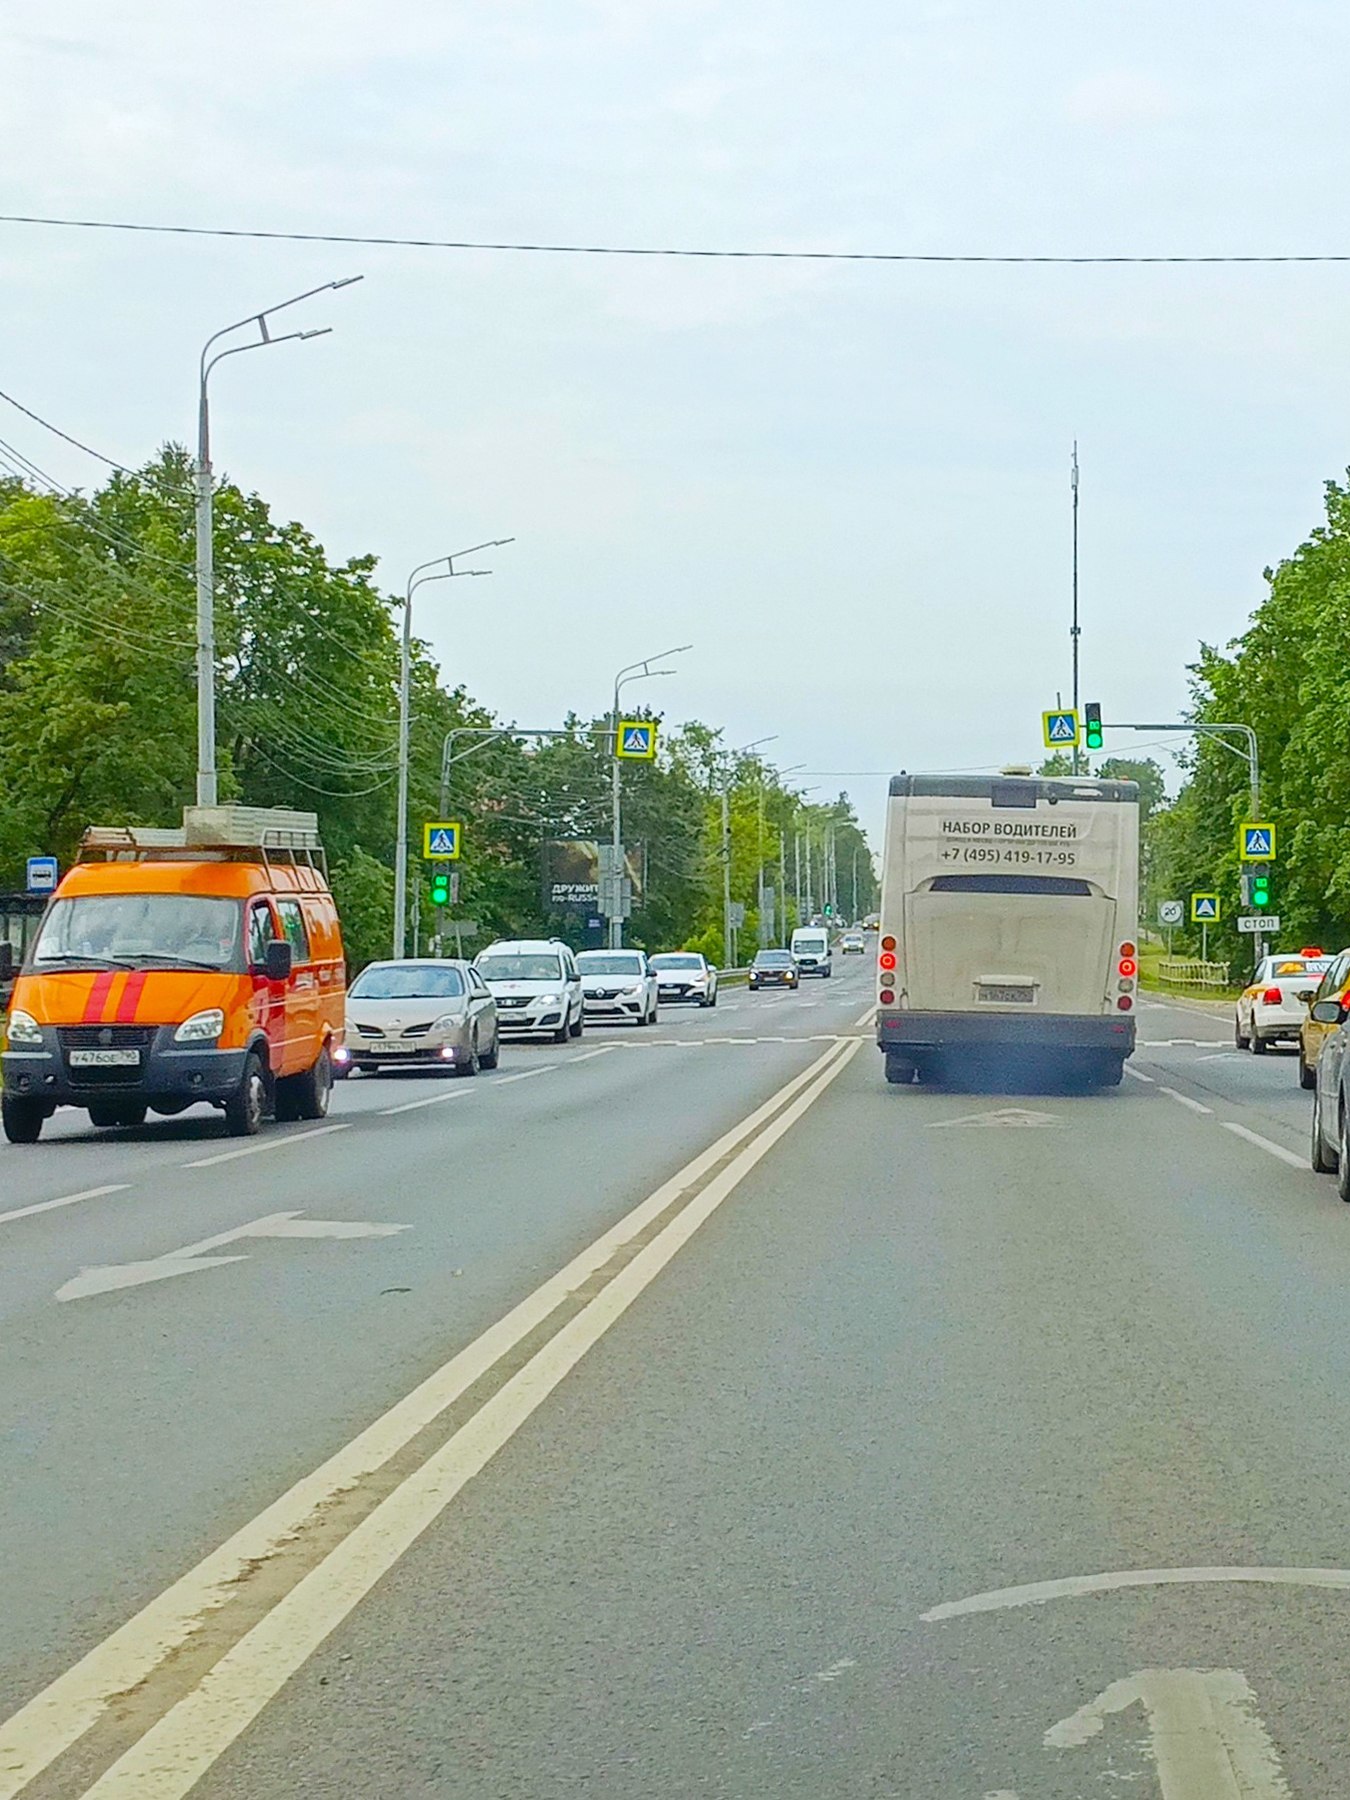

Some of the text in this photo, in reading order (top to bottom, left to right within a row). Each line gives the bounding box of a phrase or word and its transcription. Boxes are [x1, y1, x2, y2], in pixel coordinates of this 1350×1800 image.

[942, 821, 1077, 838] НАБОР ВОДИТЕЛЕЙ
[941, 847, 1076, 865] +7 (495) 419-17-95
[551, 884, 599, 894] ДРУЖИТ
[1243, 918, 1275, 929] СТОП
